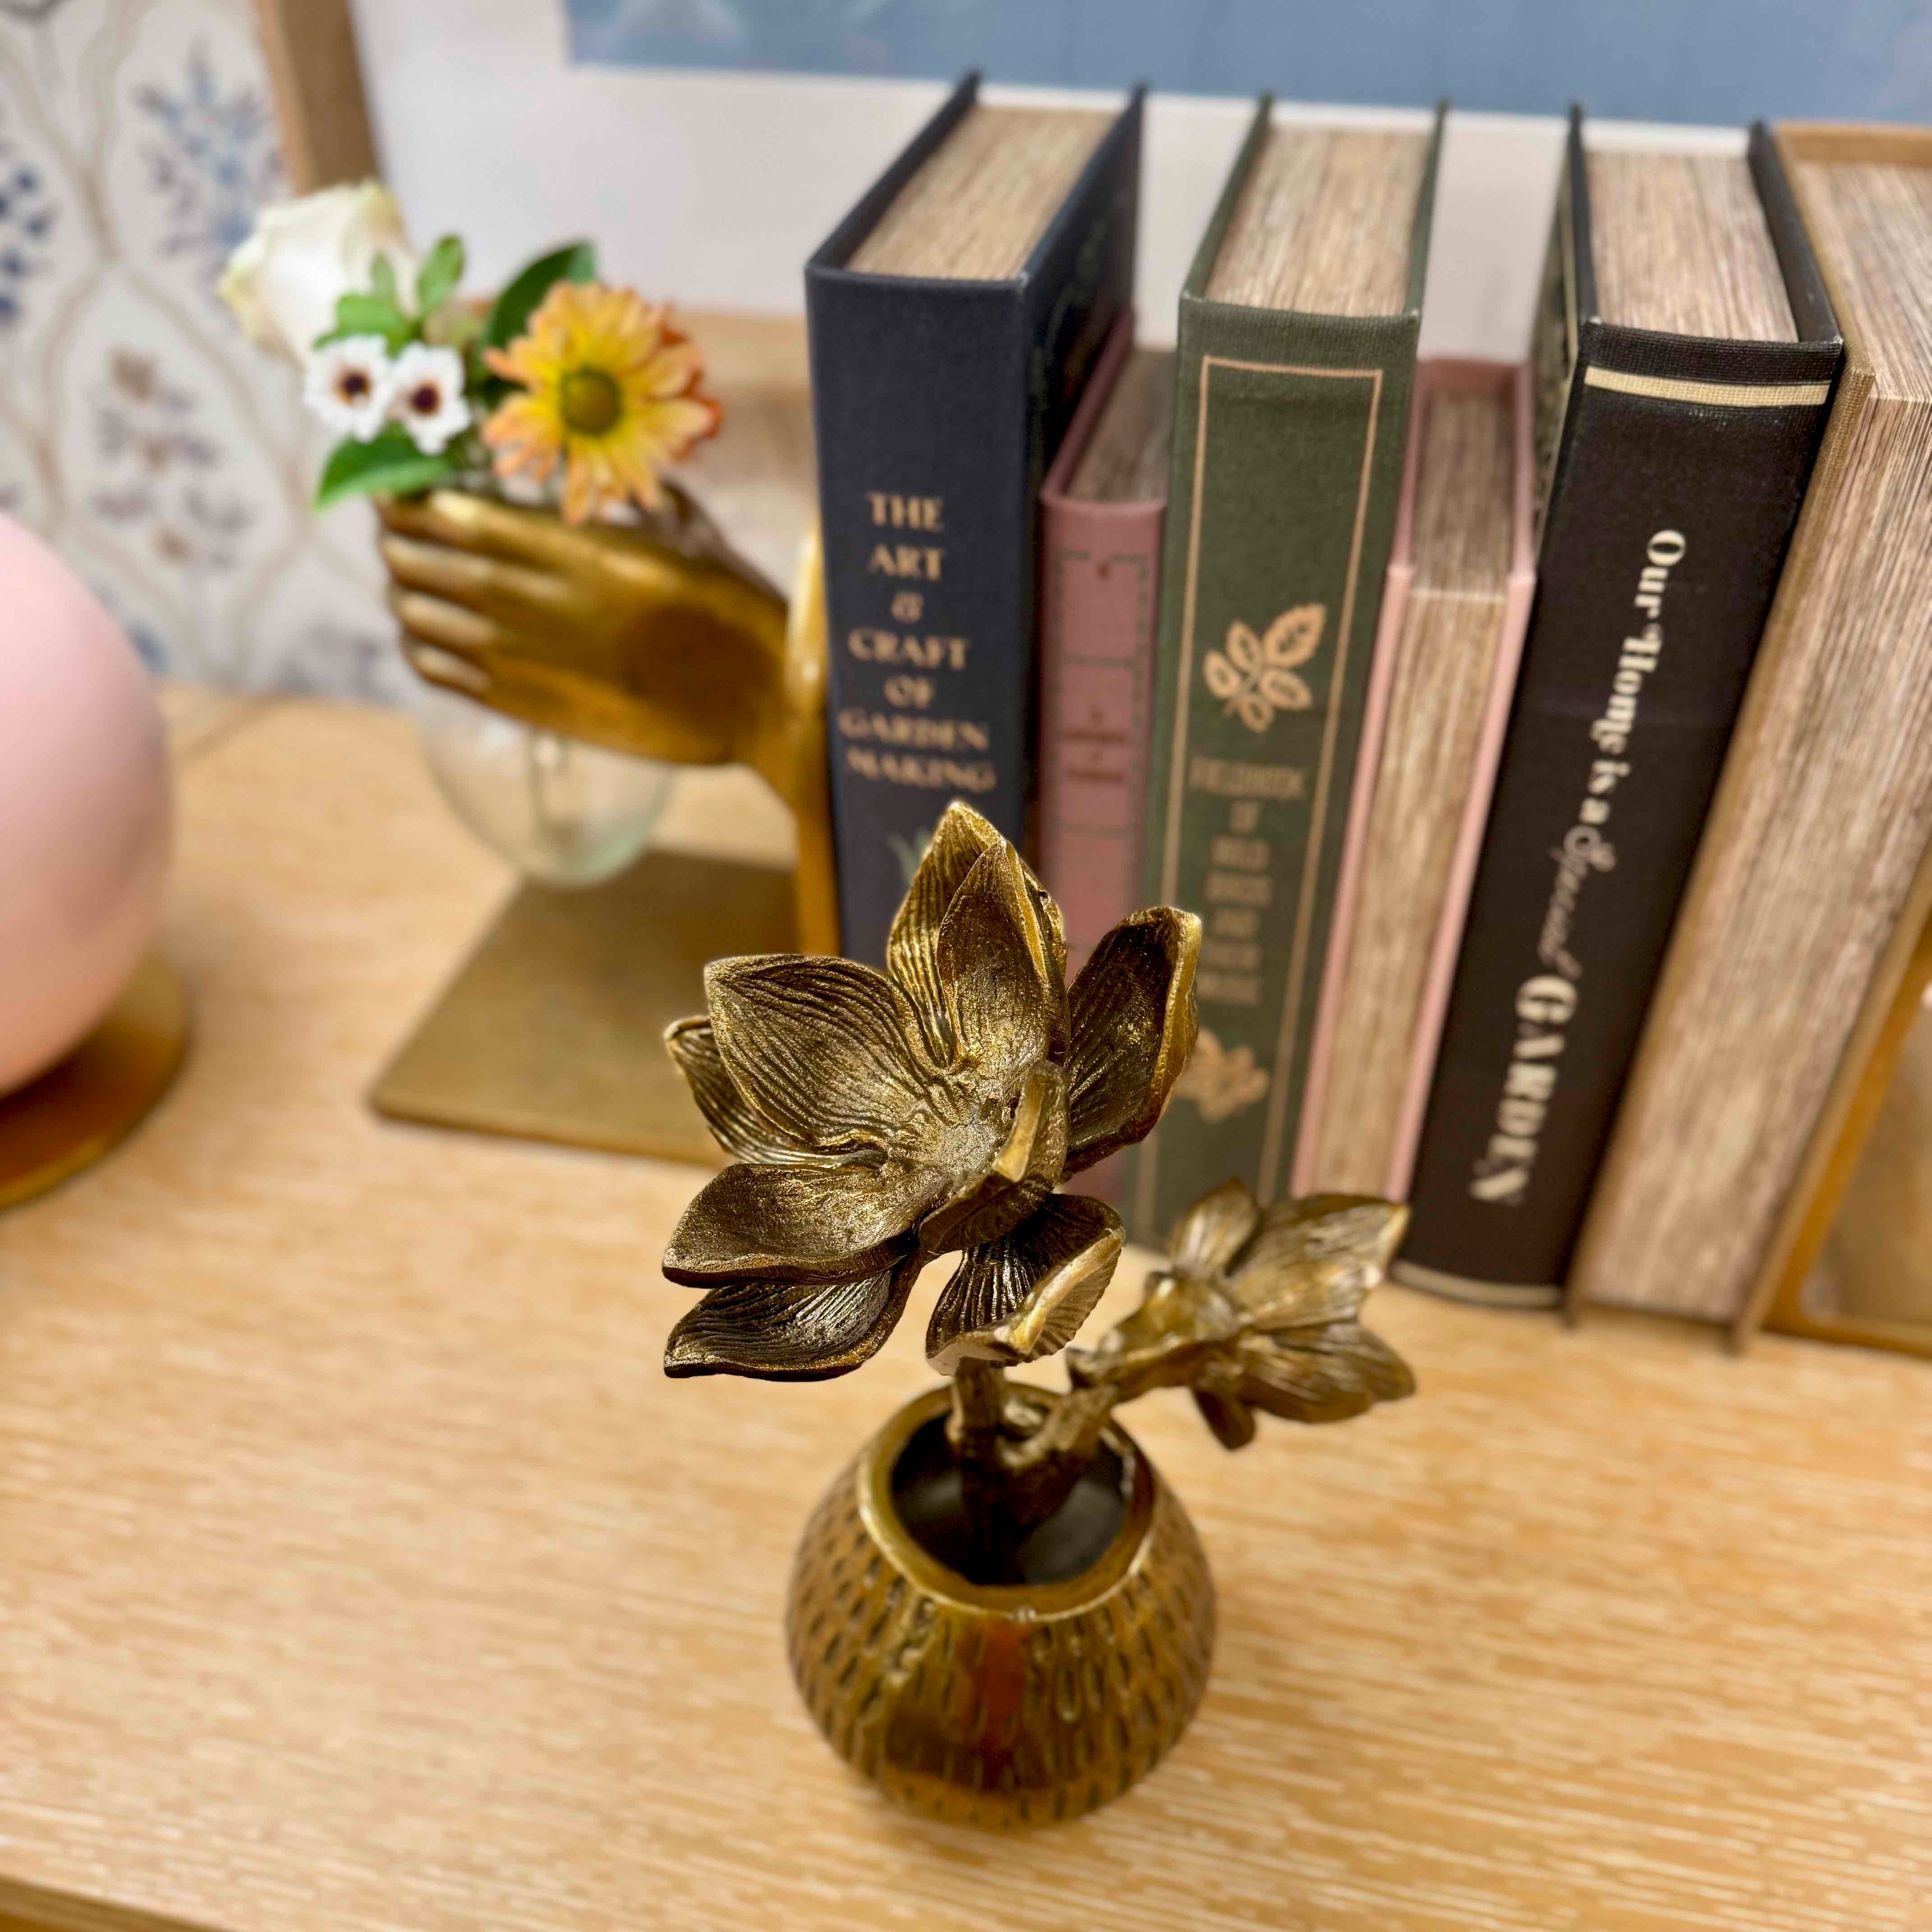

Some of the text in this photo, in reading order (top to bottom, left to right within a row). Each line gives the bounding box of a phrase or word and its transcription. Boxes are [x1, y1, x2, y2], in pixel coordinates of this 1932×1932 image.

[868, 492, 941, 531] THE
[869, 545, 943, 580] ART
[847, 629, 968, 669] CRAFT
[883, 675, 934, 708] OF
[837, 708, 989, 750] GARDEN
[845, 746, 995, 792] MAKING
[1473, 530, 1686, 1200] Our Home is a Special GARDEN
